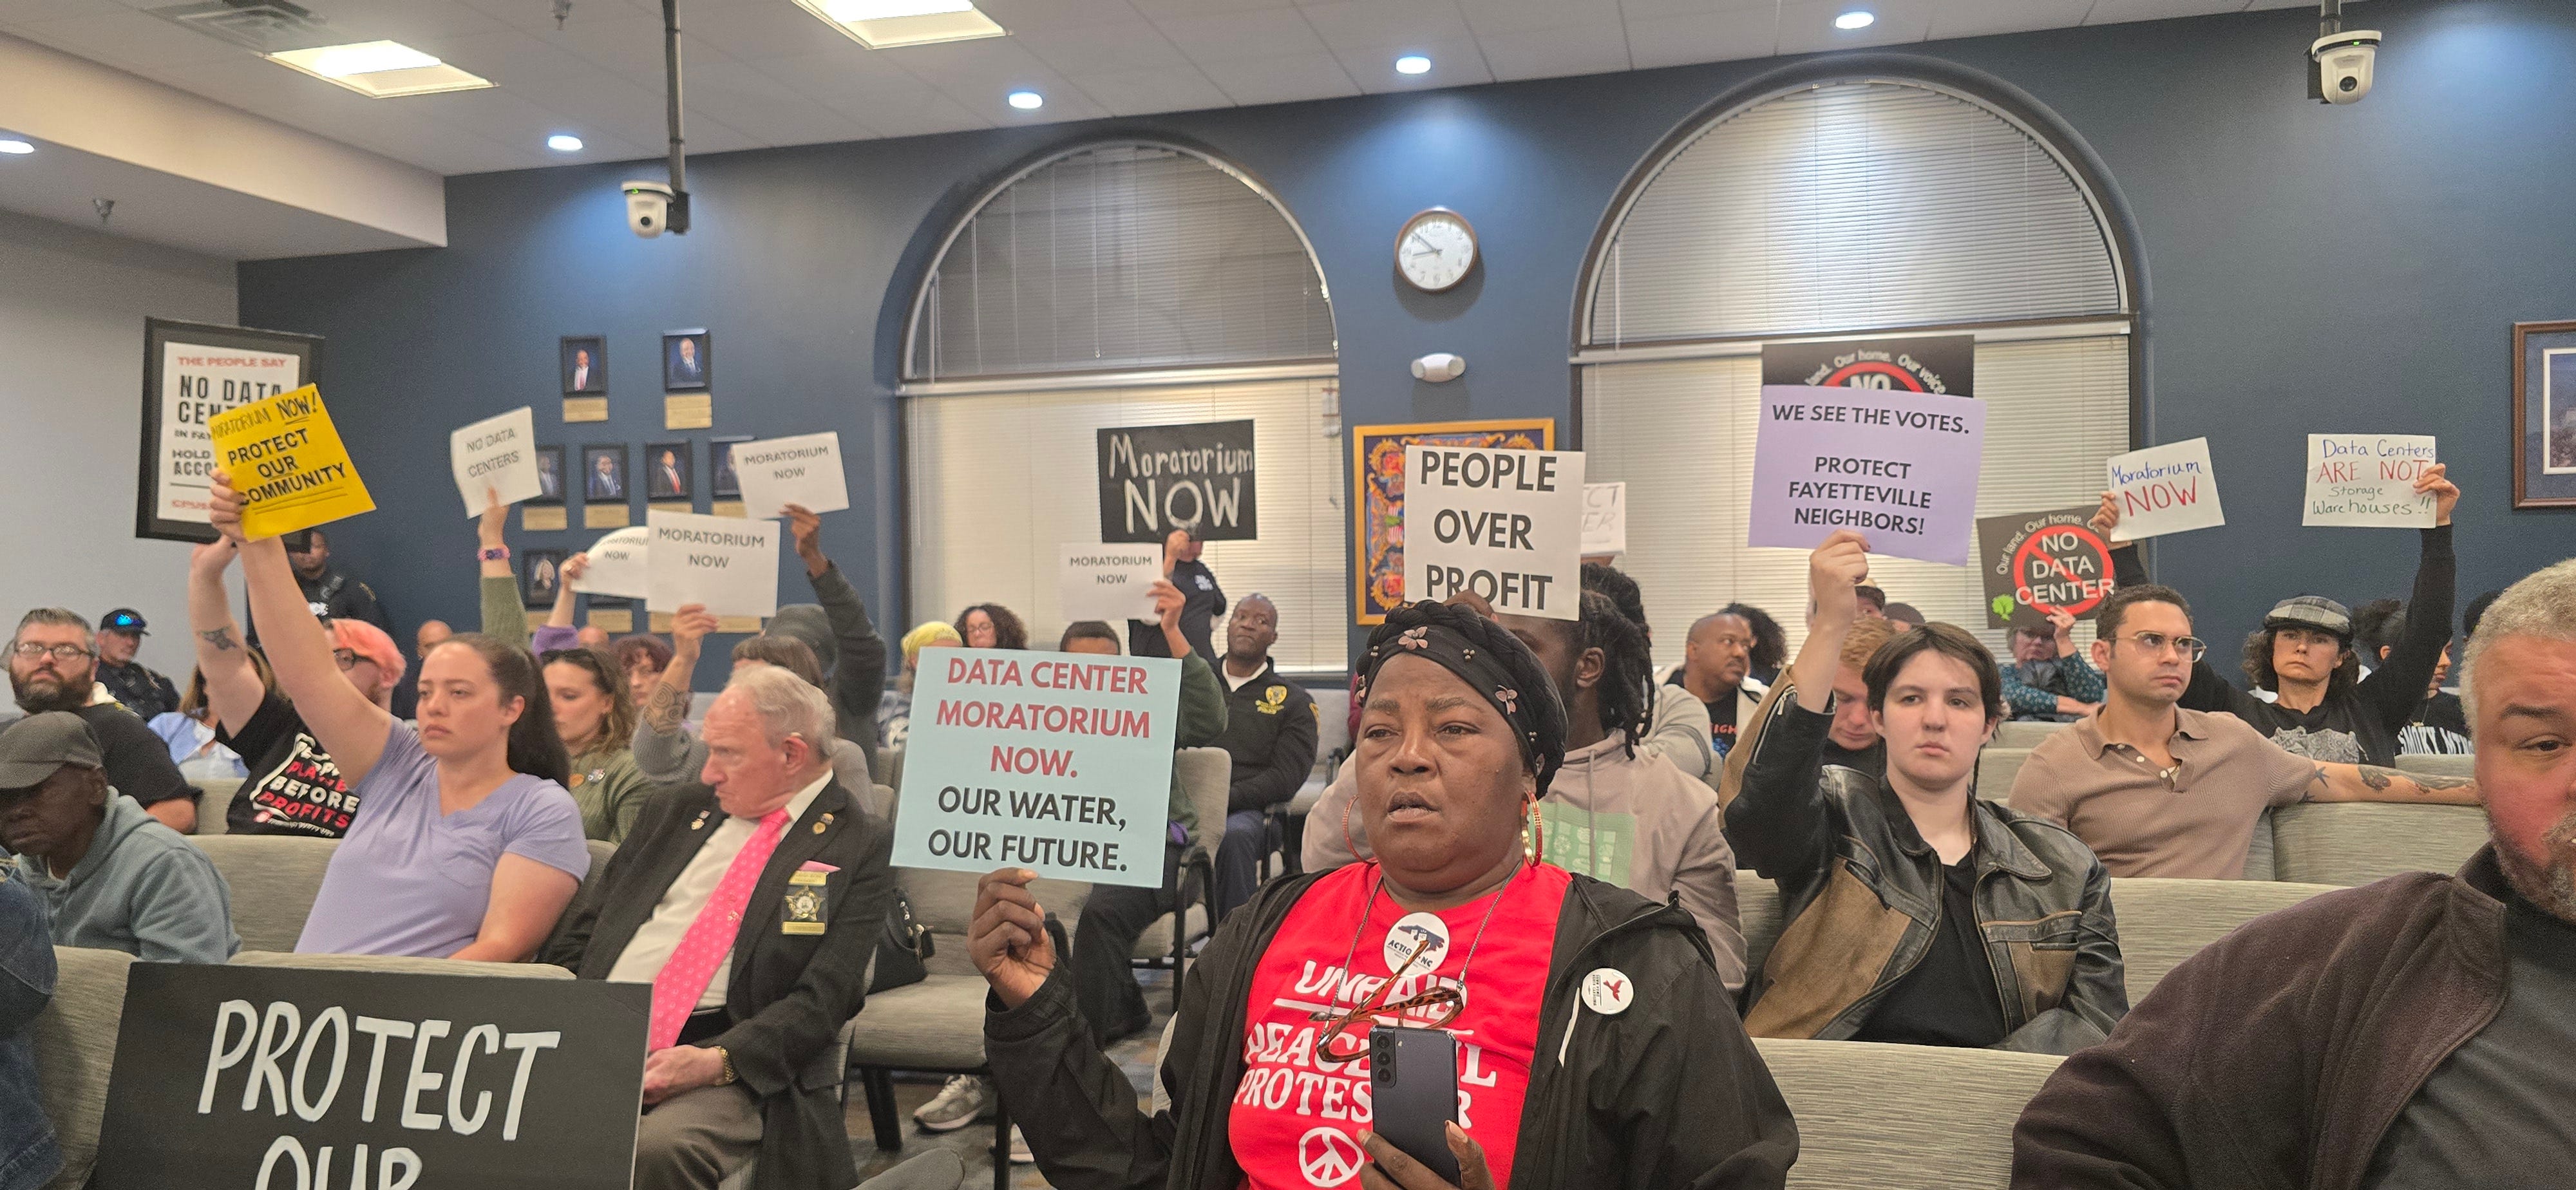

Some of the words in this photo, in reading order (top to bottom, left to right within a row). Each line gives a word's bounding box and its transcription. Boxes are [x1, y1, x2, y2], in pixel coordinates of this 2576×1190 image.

[177, 356, 204, 366] THE
[207, 357, 258, 367] PEOPLE
[261, 358, 287, 368] SAY
[1898, 354, 1922, 372] Our
[180, 375, 208, 399] NO
[1772, 404, 1804, 420] WE
[1810, 405, 1846, 422] SEE
[1852, 407, 1890, 426] THE
[1895, 410, 1969, 434] VOTES.
[173, 449, 211, 459] HOLD
[227, 428, 309, 466] PROTECT
[467, 438, 483, 453] NO
[486, 428, 516, 448] DATA
[2322, 439, 2369, 458] Data
[2377, 439, 2434, 458] Centers
[257, 456, 299, 478] OUR
[468, 451, 519, 478] CENTERS
[744, 446, 829, 465] MORATORIUM
[1108, 432, 1255, 478] Moratorium
[1814, 457, 1911, 479] PROTECT
[774, 468, 806, 479] NOW
[1421, 450, 1557, 492] PEOPLE
[2111, 460, 2202, 489] Moratorium
[2316, 461, 2362, 484] ARE
[2380, 460, 2429, 482] NOT
[1124, 477, 1241, 534] NOW
[1789, 481, 1931, 509] FAYETTEVILLE
[2124, 476, 2197, 516] NOW
[1434, 509, 1534, 551] OVER
[1794, 507, 1924, 535] NEIGHBORS!
[659, 528, 764, 548] MORATORIUM
[1996, 552, 2010, 575] Our
[2025, 518, 2046, 533] Our
[2041, 532, 2078, 553] NO
[605, 551, 630, 560] NOW
[688, 554, 730, 568] NOW
[1070, 556, 1153, 567] MORATORIUM
[2032, 555, 2094, 579] DATA
[1097, 574, 1128, 584] NOW
[1426, 564, 1553, 610] PROFIT
[2015, 578, 2115, 605] CENTER
[947, 657, 1023, 686] DATA
[1030, 661, 1148, 694] CENTER
[936, 699, 1150, 739] MORATORIUM
[990, 745, 1077, 778] NOW.
[269, 775, 360, 814] BEFORE
[938, 786, 1002, 817] OUR
[1009, 790, 1126, 831] WATER,
[258, 791, 351, 829] PROFITS
[928, 829, 992, 860] OUR
[1000, 835, 1128, 872] FUTURE.
[1388, 940, 1412, 955] ACTIO
[1421, 956, 1433, 967] NC
[1245, 1021, 1497, 1088] PEACEL
[197, 999, 561, 1140] PROTECT
[1233, 1067, 1472, 1129] PROTESR
